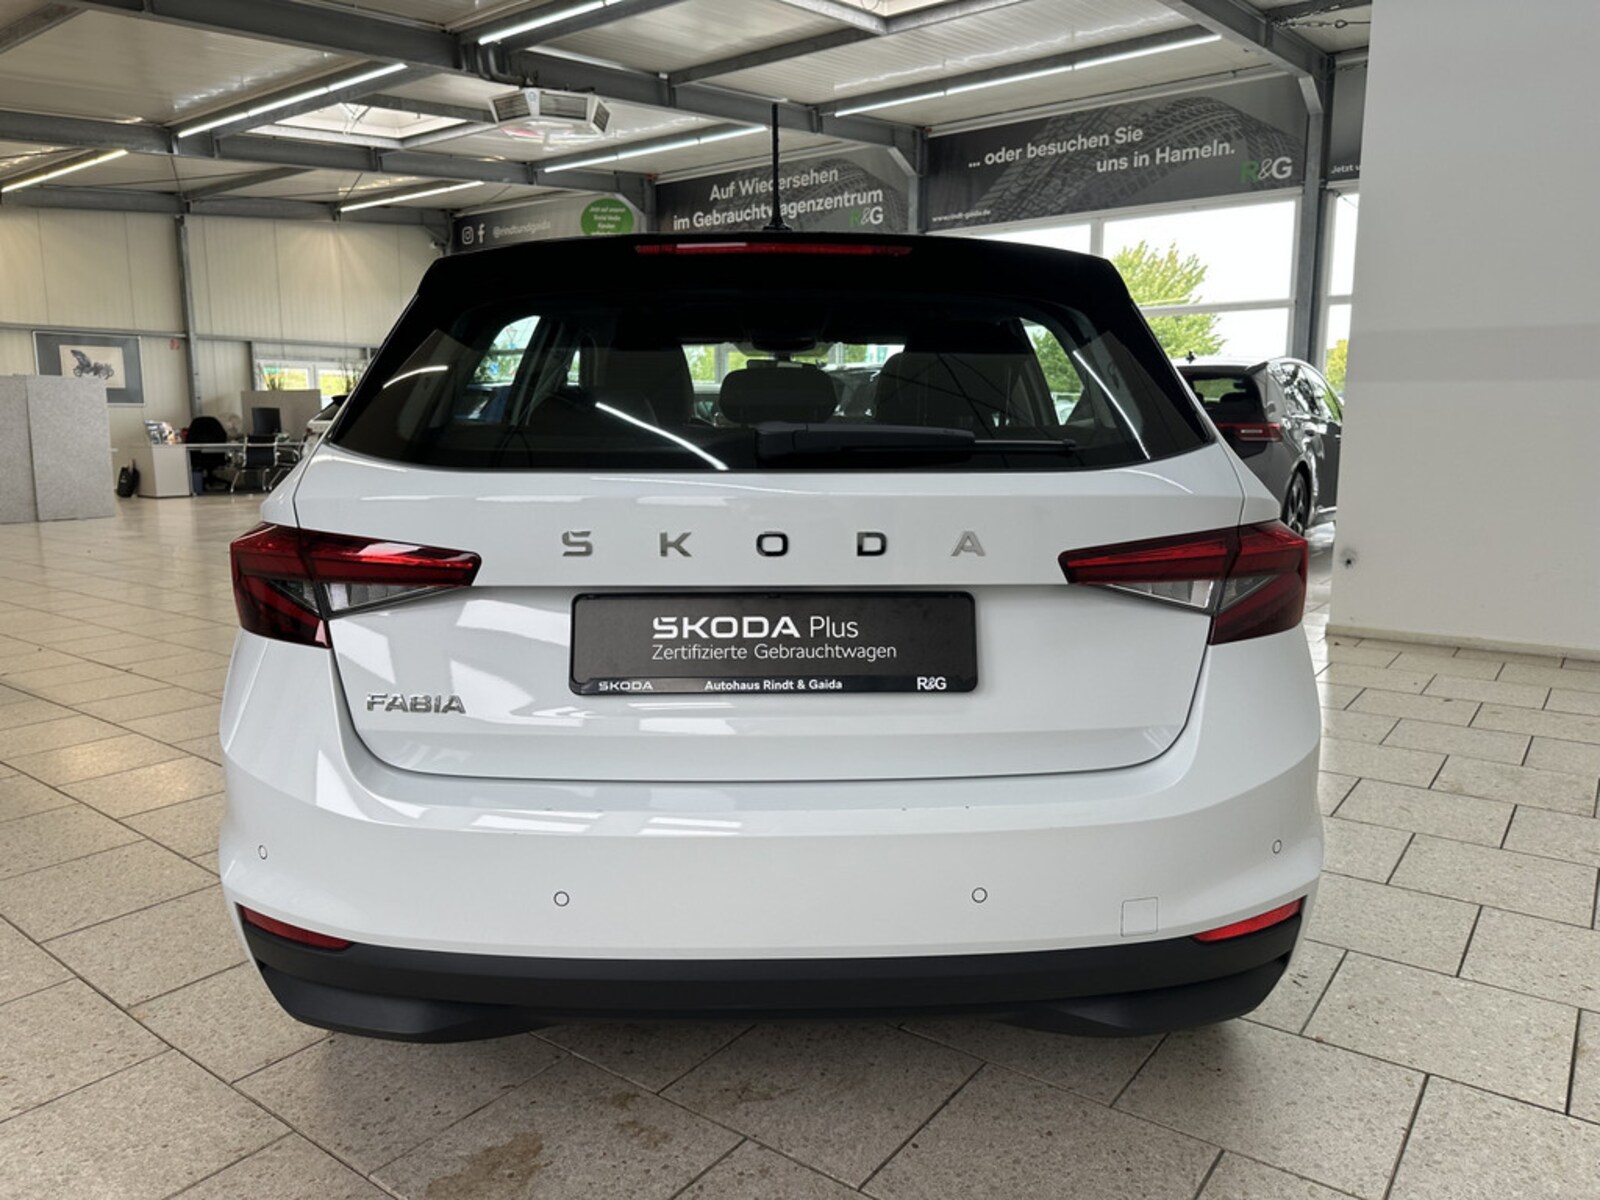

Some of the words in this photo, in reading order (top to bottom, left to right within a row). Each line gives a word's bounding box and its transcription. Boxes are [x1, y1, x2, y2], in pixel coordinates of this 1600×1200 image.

[984, 147, 1022, 165] oder
[1027, 133, 1110, 159] besuchen
[1114, 125, 1143, 144] Sie
[1096, 157, 1128, 173] uns
[1133, 151, 1149, 168] in
[1156, 139, 1235, 164] Hameln.
[1239, 156, 1293, 184] R&G
[710, 181, 736, 201] Auf
[673, 214, 690, 231] im
[850, 205, 884, 226] R&G
[561, 530, 986, 558] SKODA
[652, 616, 801, 639] SKODA
[809, 615, 859, 638] Plus
[652, 644, 747, 660] Zertifizierte
[754, 643, 897, 662] Gebrauchtwagen
[598, 680, 653, 691] SKODA
[704, 680, 760, 691] Autohaus
[763, 679, 794, 690] Rindt
[797, 679, 806, 690] &
[808, 679, 843, 690] Gaida
[916, 676, 948, 691] R&G
[366, 693, 467, 714] FABIA
